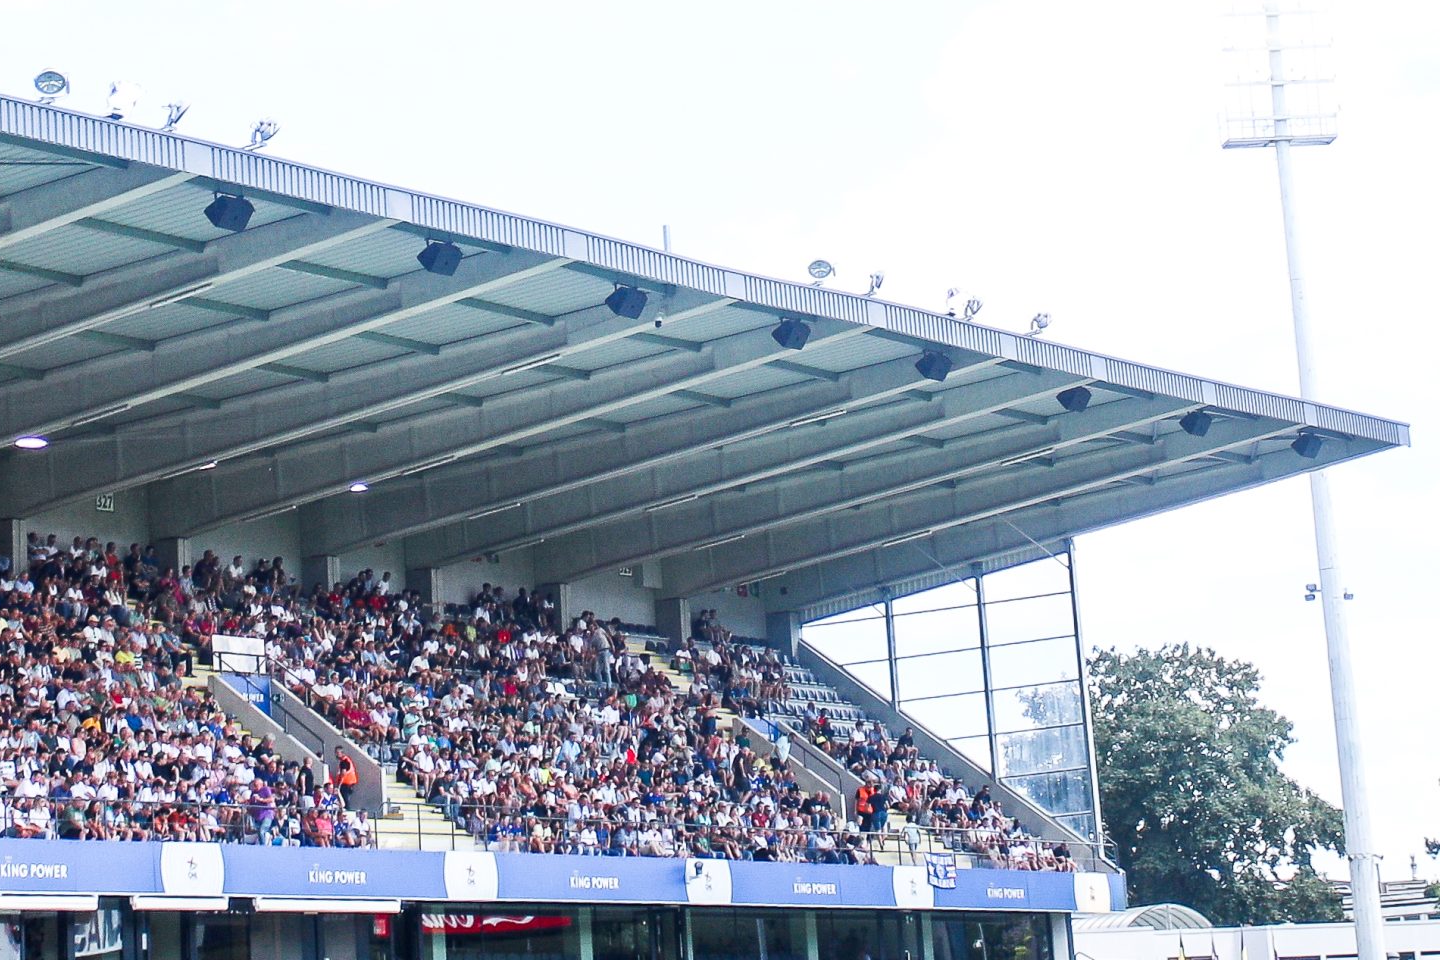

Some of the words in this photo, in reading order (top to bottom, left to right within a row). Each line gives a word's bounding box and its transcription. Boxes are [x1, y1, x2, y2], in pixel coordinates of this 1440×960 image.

[0, 863, 28, 878] KING
[30, 863, 67, 878] POWER
[309, 870, 333, 884] KING
[334, 871, 366, 884] POWER
[570, 876, 591, 888] KING
[591, 876, 619, 889] POWER
[793, 882, 811, 894] KING
[812, 882, 836, 895] POWER
[987, 887, 1003, 898] KING
[1003, 887, 1024, 899] POWER
